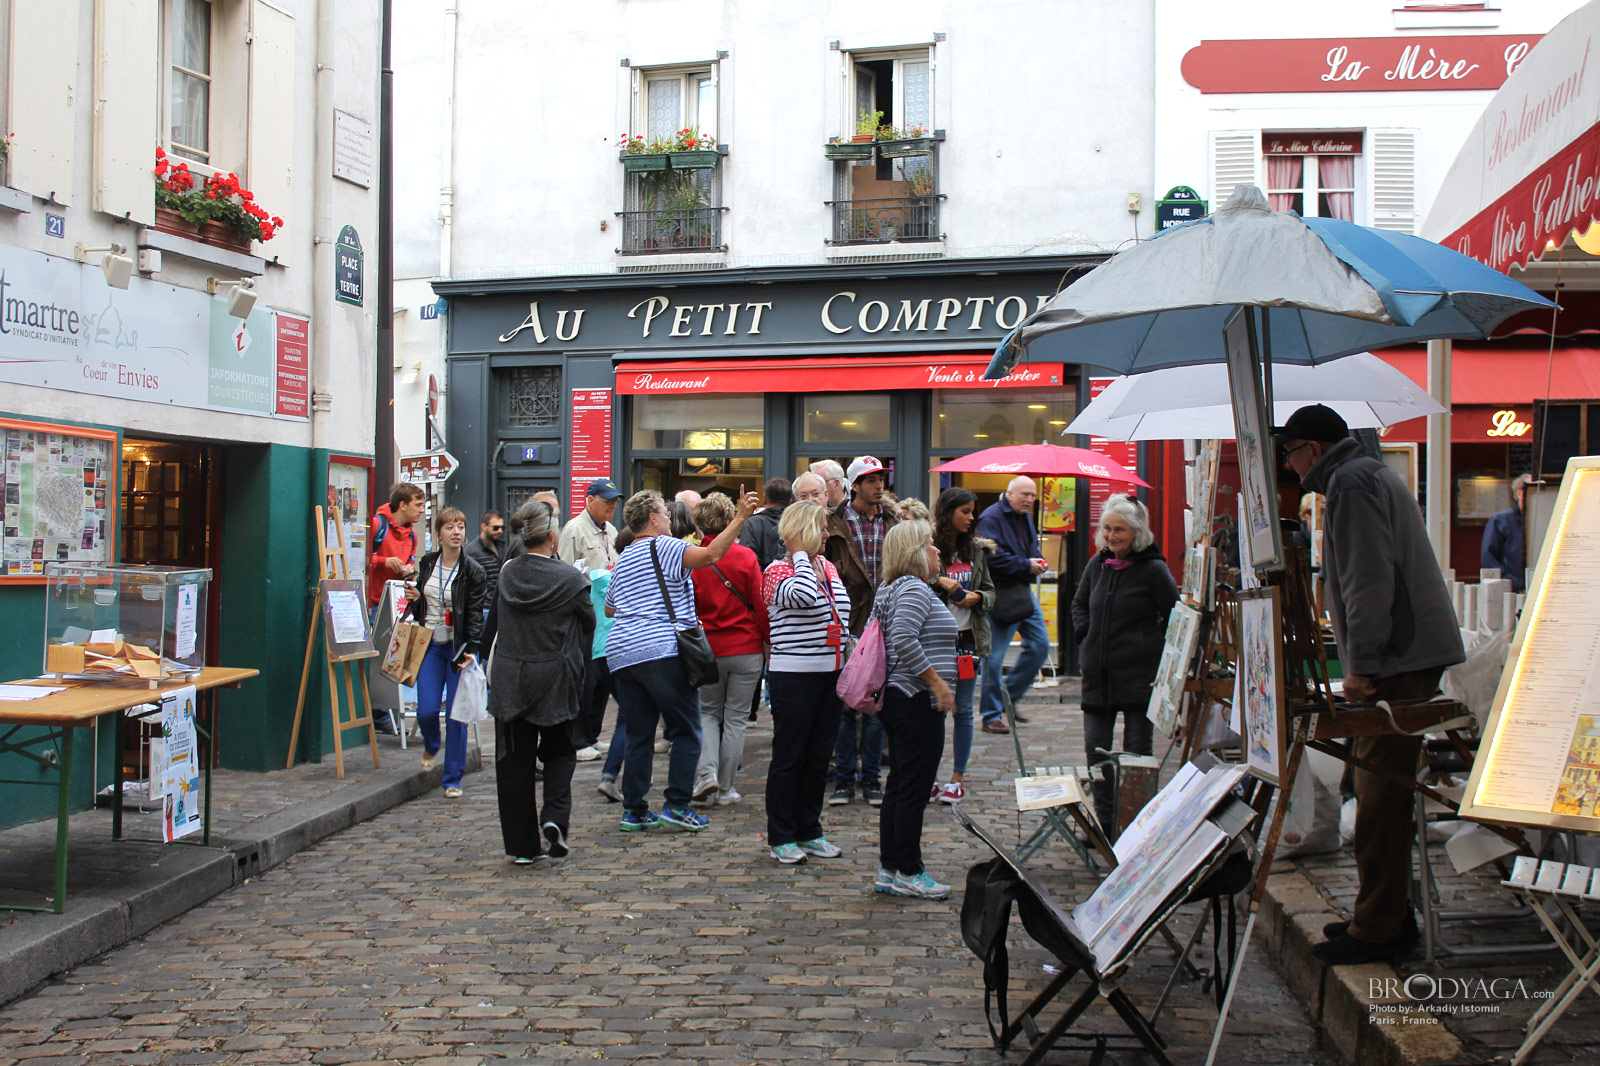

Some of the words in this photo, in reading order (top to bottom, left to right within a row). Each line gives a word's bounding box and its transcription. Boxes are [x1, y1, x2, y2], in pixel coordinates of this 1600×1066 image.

[1321, 45, 1369, 82] La
[1384, 44, 1479, 81] Mère
[1504, 43, 1528, 77] C
[1488, 36, 1592, 171] Restaurant
[1270, 140, 1283, 153] La
[1311, 139, 1353, 152] Catherine
[1173, 208, 1190, 217] RUE
[49, 216, 62, 236] 21
[1484, 206, 1526, 265] Mère
[341, 256, 358, 271] PLACE
[340, 280, 360, 296] TERTRE
[422, 303, 435, 319] 10
[498, 301, 586, 344] AU
[627, 295, 773, 338] PETIT
[12, 327, 43, 341] SYNDICAT
[44, 333, 79, 347] D'INITIATIVE
[83, 364, 108, 382] Coeur
[117, 364, 159, 390] Envies
[210, 367, 270, 387] INFORMATIONS
[633, 373, 711, 390] Restaurant
[925, 366, 962, 383] Vente
[965, 370, 976, 382] à
[209, 385, 269, 404] TOURISTIQUES
[1486, 410, 1532, 437] La
[525, 447, 534, 460] 8
[981, 462, 1028, 473] Coca-Cola
[1078, 462, 1111, 477] Coca-Cola
